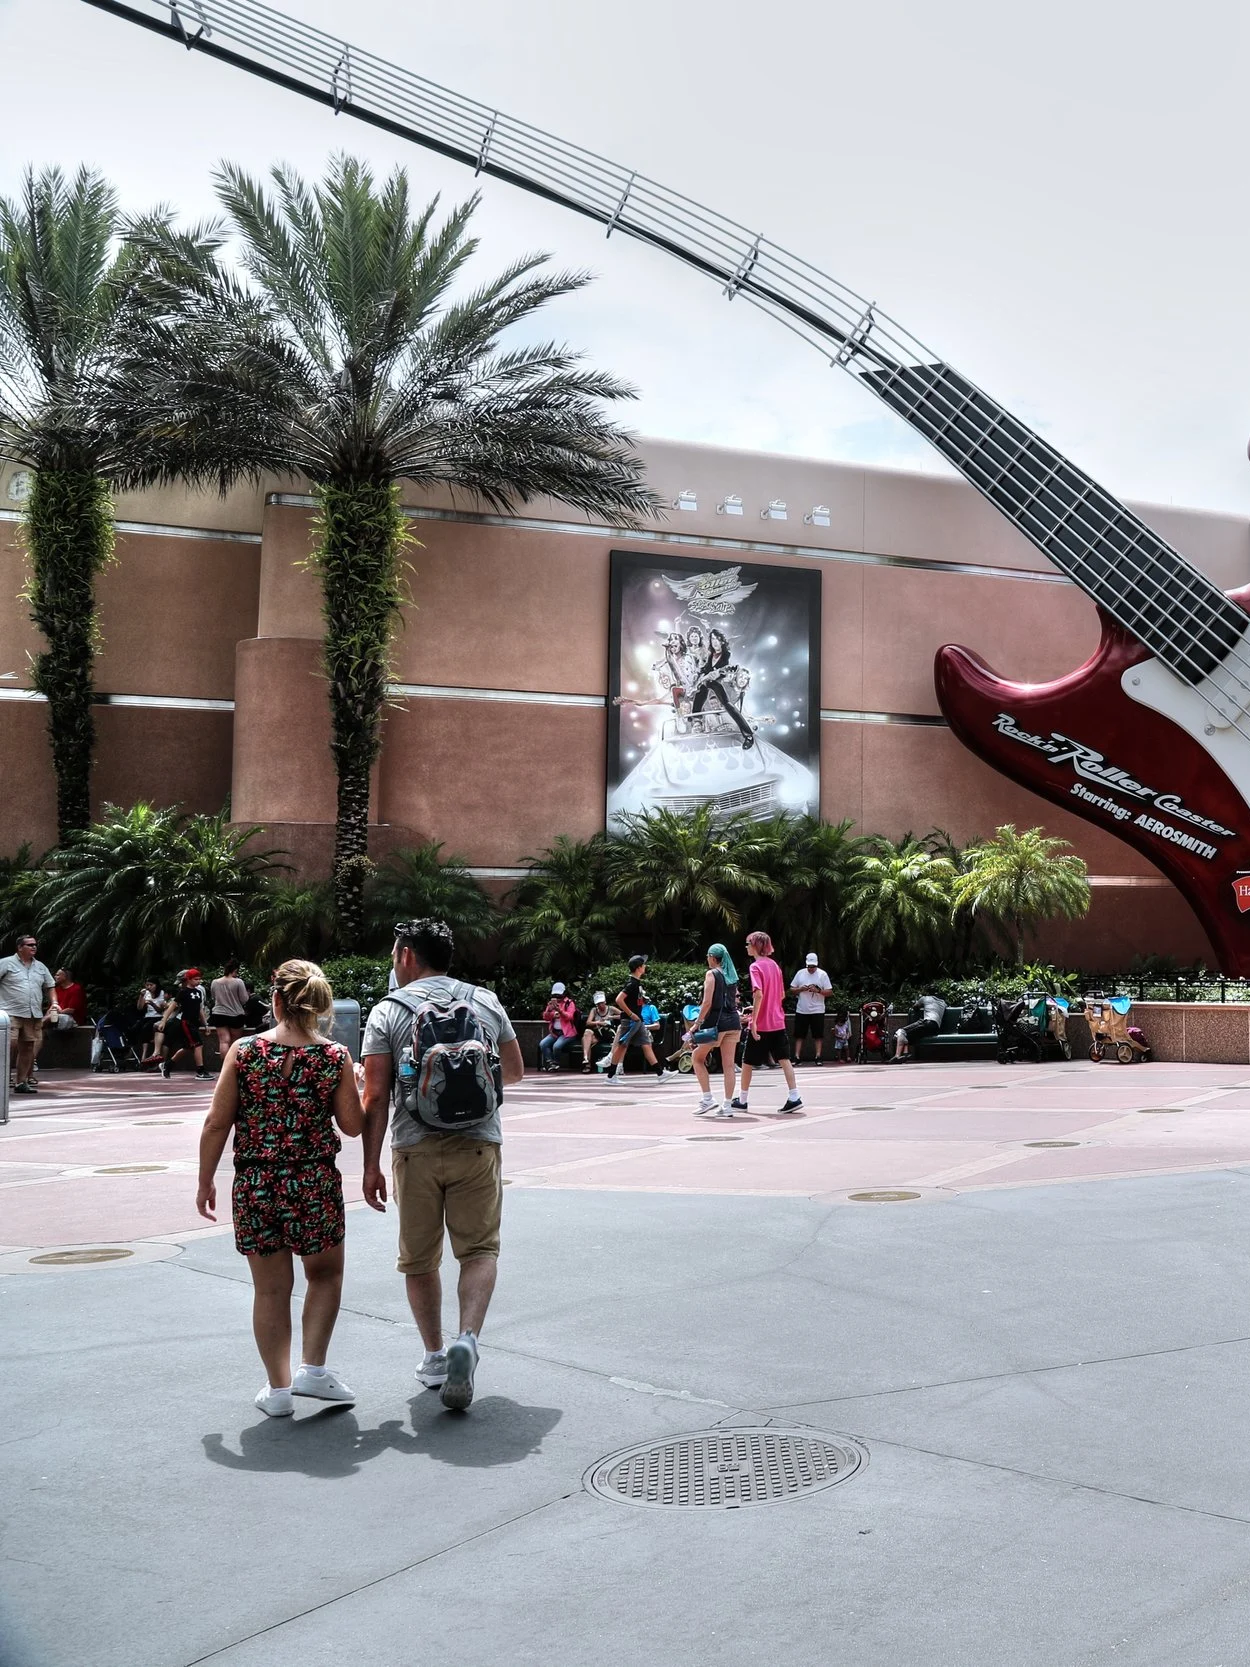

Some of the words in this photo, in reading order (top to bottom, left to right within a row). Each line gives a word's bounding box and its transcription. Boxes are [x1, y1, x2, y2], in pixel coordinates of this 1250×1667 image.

[1047, 732, 1158, 800] Roller
[1153, 795, 1236, 836] Coaster
[1070, 783, 1132, 820] Starring:
[1133, 813, 1218, 860] AEROSMITH
